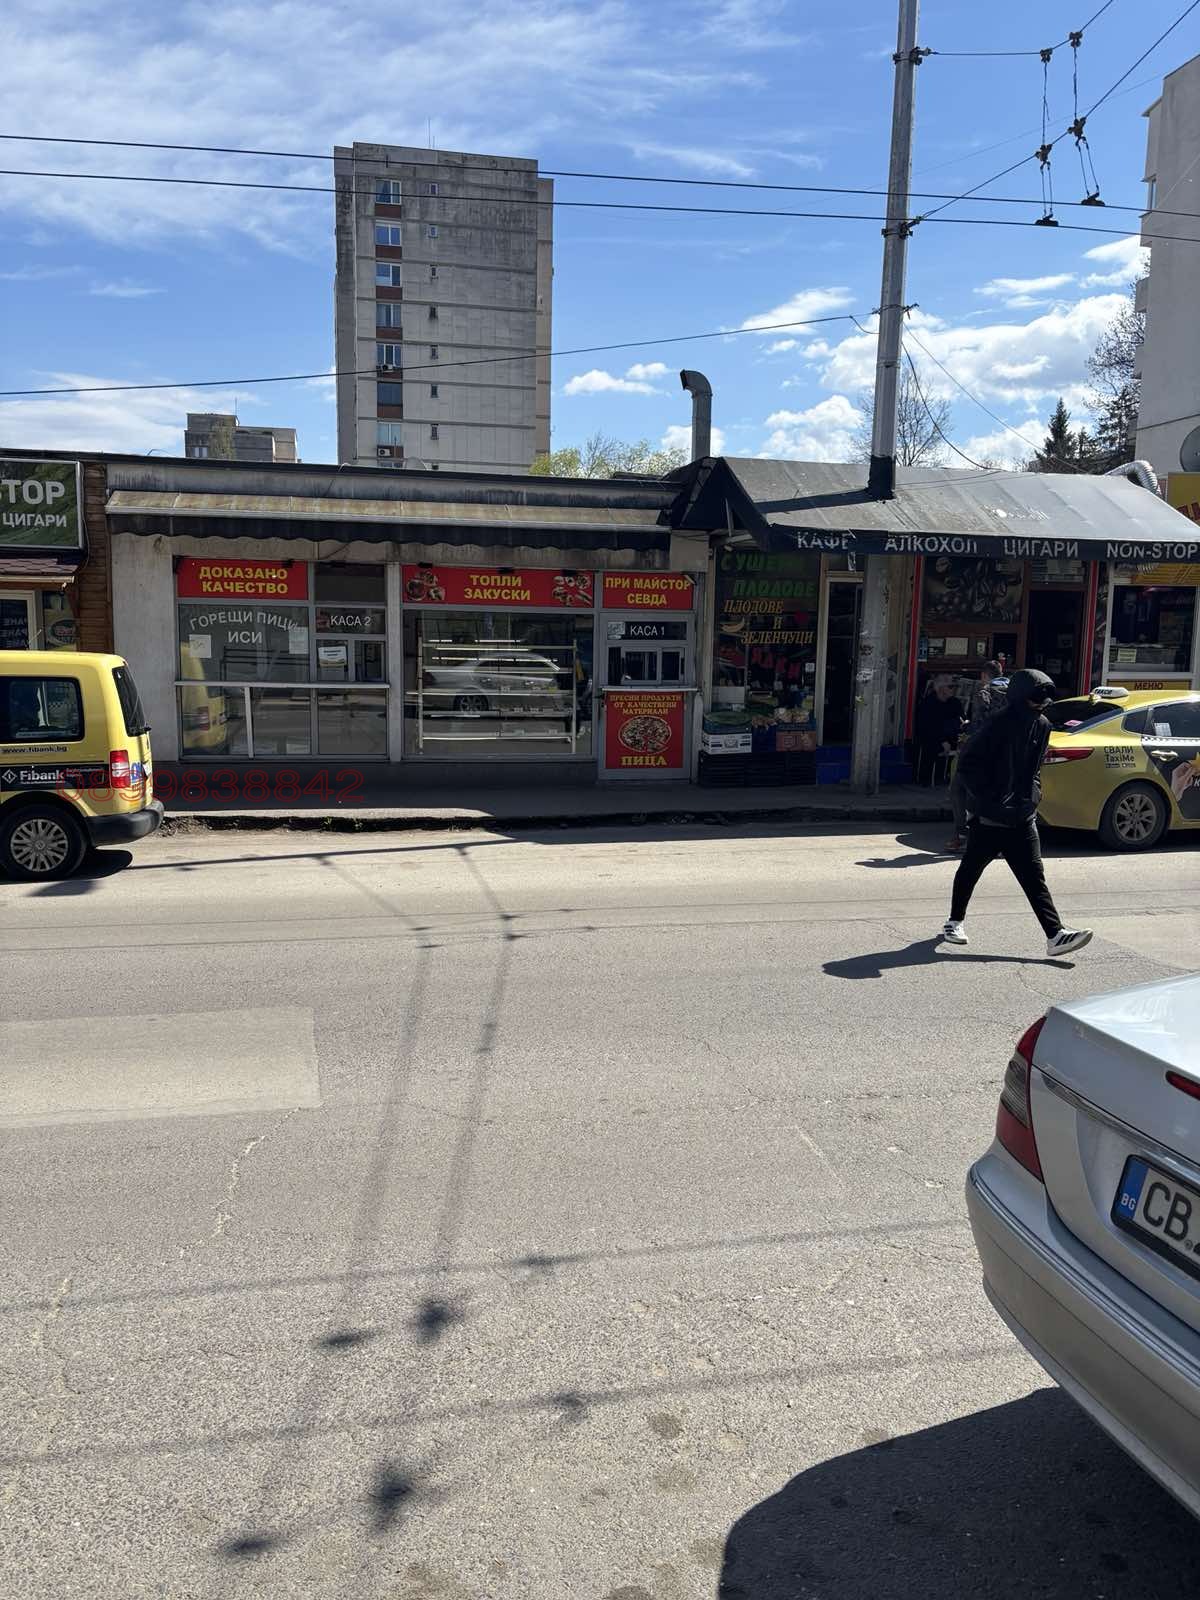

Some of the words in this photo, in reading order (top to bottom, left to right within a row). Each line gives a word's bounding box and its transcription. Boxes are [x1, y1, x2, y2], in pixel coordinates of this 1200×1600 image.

[0, 479, 66, 505] TOP
[2, 512, 67, 528] ЦИГАРИ
[797, 532, 850, 550] КАФЕ
[884, 534, 978, 554] АЛКОХОЛ
[1003, 539, 1079, 558] ЦИГАРИ
[1106, 542, 1197, 559] NON-STOP
[200, 567, 288, 580] ДОКАЗАНО
[202, 581, 288, 594] КАЧЕСТВО
[469, 575, 522, 587] ТОПЛИ
[605, 577, 630, 588] ПРИ
[633, 577, 690, 591] МАЙСТОР
[464, 588, 531, 601] ЗАКУСКИ
[627, 593, 668, 606] СЕВДА
[723, 600, 784, 615] ПЛОДОВЕ
[189, 611, 253, 631] ГОРЕЩИ
[257, 612, 300, 631] ПИЦИ
[330, 615, 361, 626] КАСА
[364, 616, 372, 626] 2
[630, 625, 658, 636] КАСА
[661, 626, 665, 636] 1
[228, 631, 263, 644] ИСИ
[741, 631, 814, 646] ЗЕЛЕНЧУЦИ
[1134, 681, 1164, 691] МЕНЮ
[1103, 746, 1134, 754] СВАЛИ
[621, 756, 667, 767] ПИЦА
[1104, 754, 1135, 762] TaxiMe
[19, 769, 65, 781] Fibank
[1120, 1193, 1136, 1210] BG
